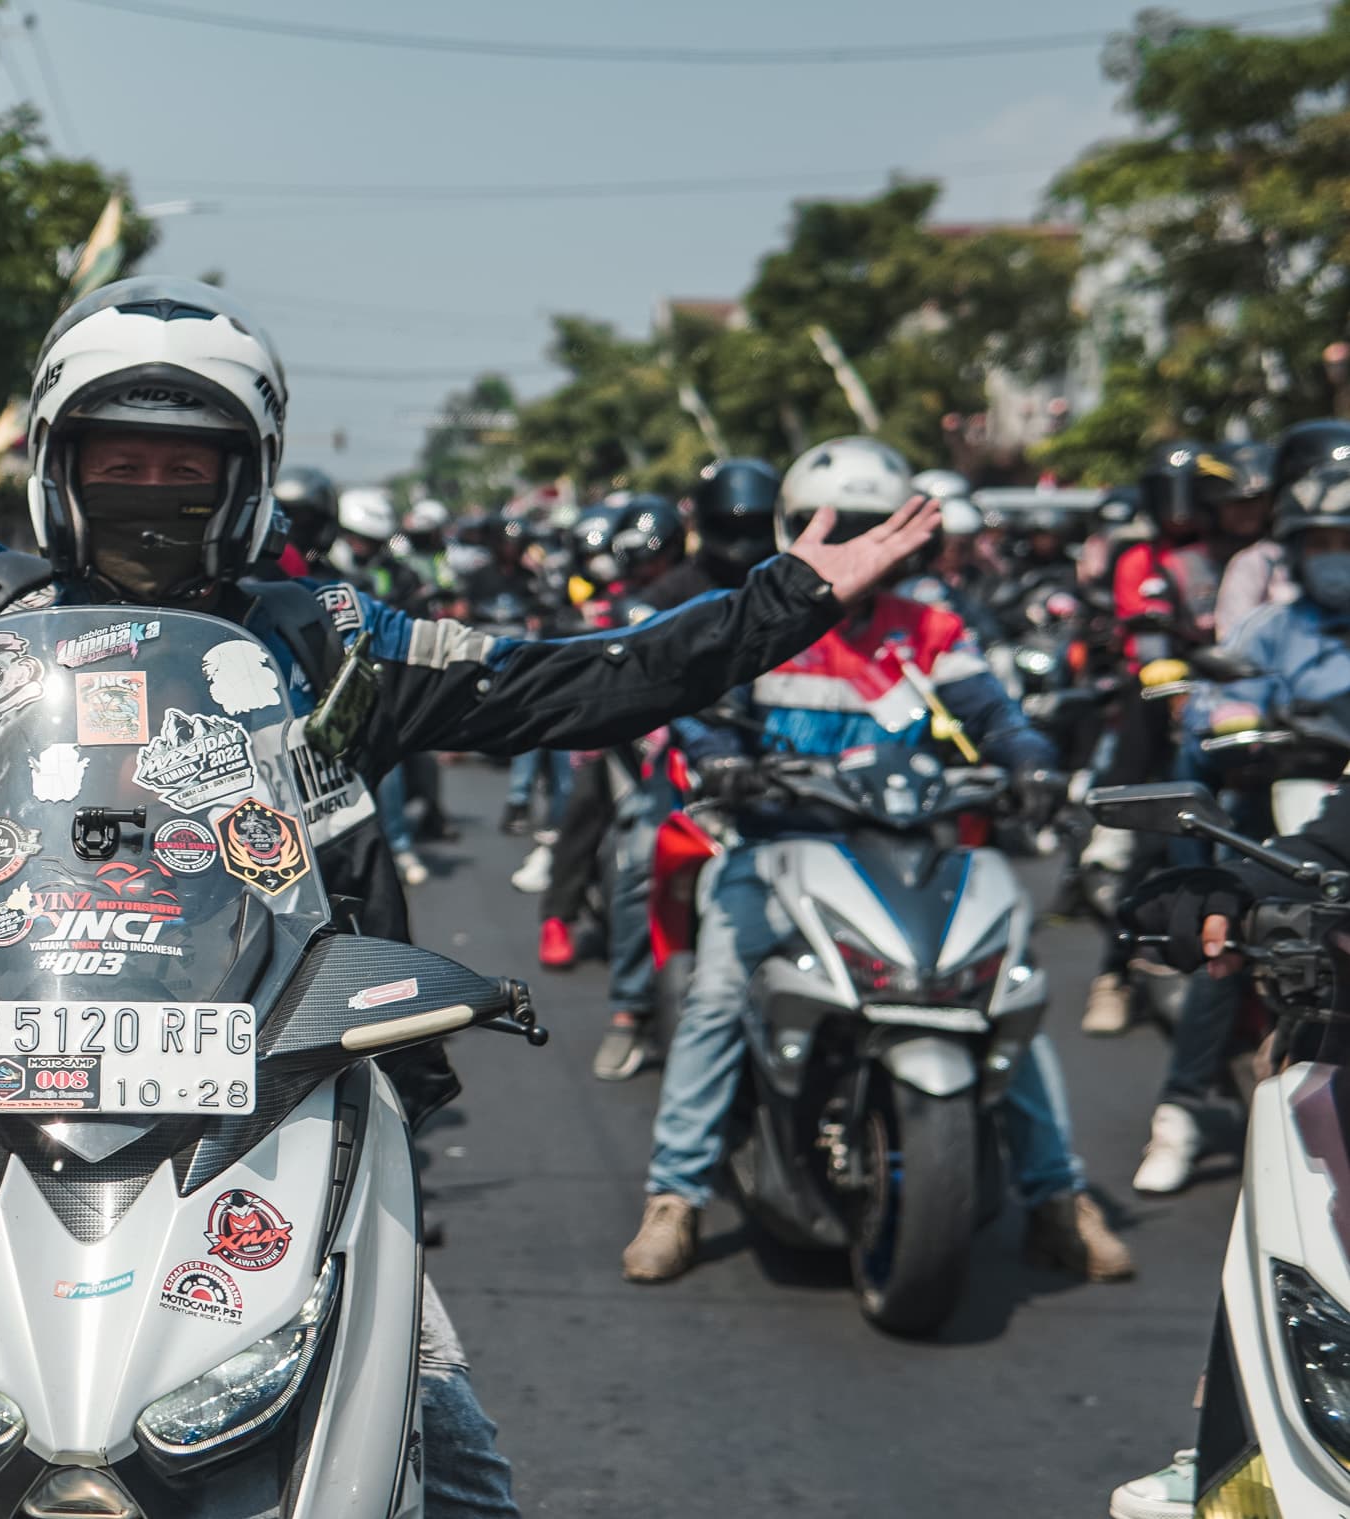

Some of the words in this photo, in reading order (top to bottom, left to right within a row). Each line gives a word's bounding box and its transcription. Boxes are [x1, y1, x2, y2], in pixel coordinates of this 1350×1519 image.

[127, 388, 189, 403] MDS
[204, 728, 239, 752] DAY
[208, 744, 244, 768] 2022
[158, 763, 198, 785] YAMAHA
[33, 892, 92, 910] VINZ
[96, 900, 183, 915] MOTORSPORT
[29, 941, 69, 951] YAMAHA
[71, 941, 100, 950] NMAX
[102, 941, 128, 951] CLUB
[130, 943, 184, 957] INDONESIA
[39, 951, 127, 976] #003
[14, 1007, 140, 1053] 5120
[161, 1008, 252, 1055] RFG
[28, 1058, 97, 1068] MOTOCAMP
[36, 1070, 89, 1089] 008
[208, 1227, 292, 1254] XMAX
[229, 1256, 257, 1268] JAWA
[256, 1248, 282, 1267] TIMUR
[164, 1261, 201, 1288] CHAPTER
[203, 1263, 242, 1306] LUMAJANG
